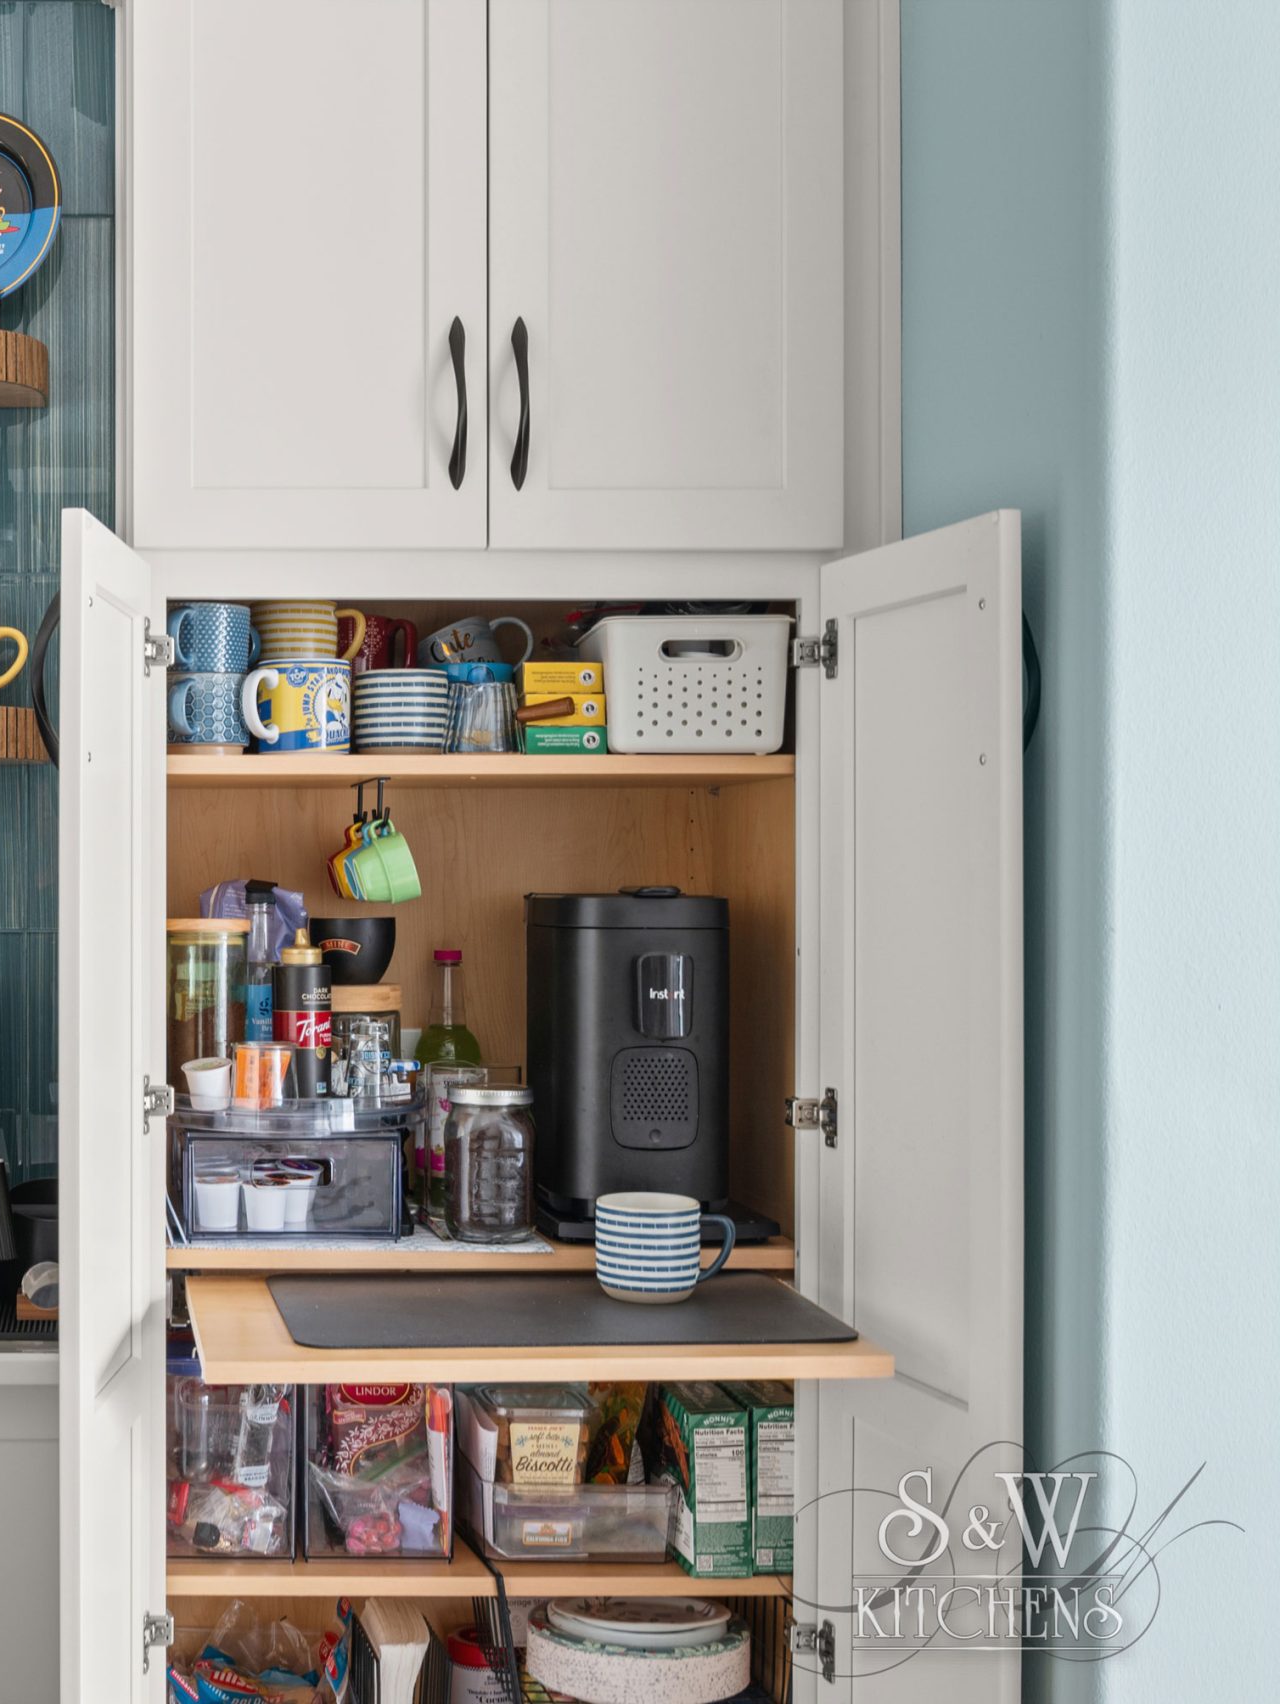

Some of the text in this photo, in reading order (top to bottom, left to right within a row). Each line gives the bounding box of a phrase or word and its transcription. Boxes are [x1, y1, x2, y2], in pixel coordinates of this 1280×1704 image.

[296, 1016, 332, 1042] Torani
[355, 1386, 397, 1397] LINDOR
[703, 1415, 735, 1426] NONNI'S
[731, 1449, 745, 1457] 100
[515, 1455, 573, 1472] Biscotti
